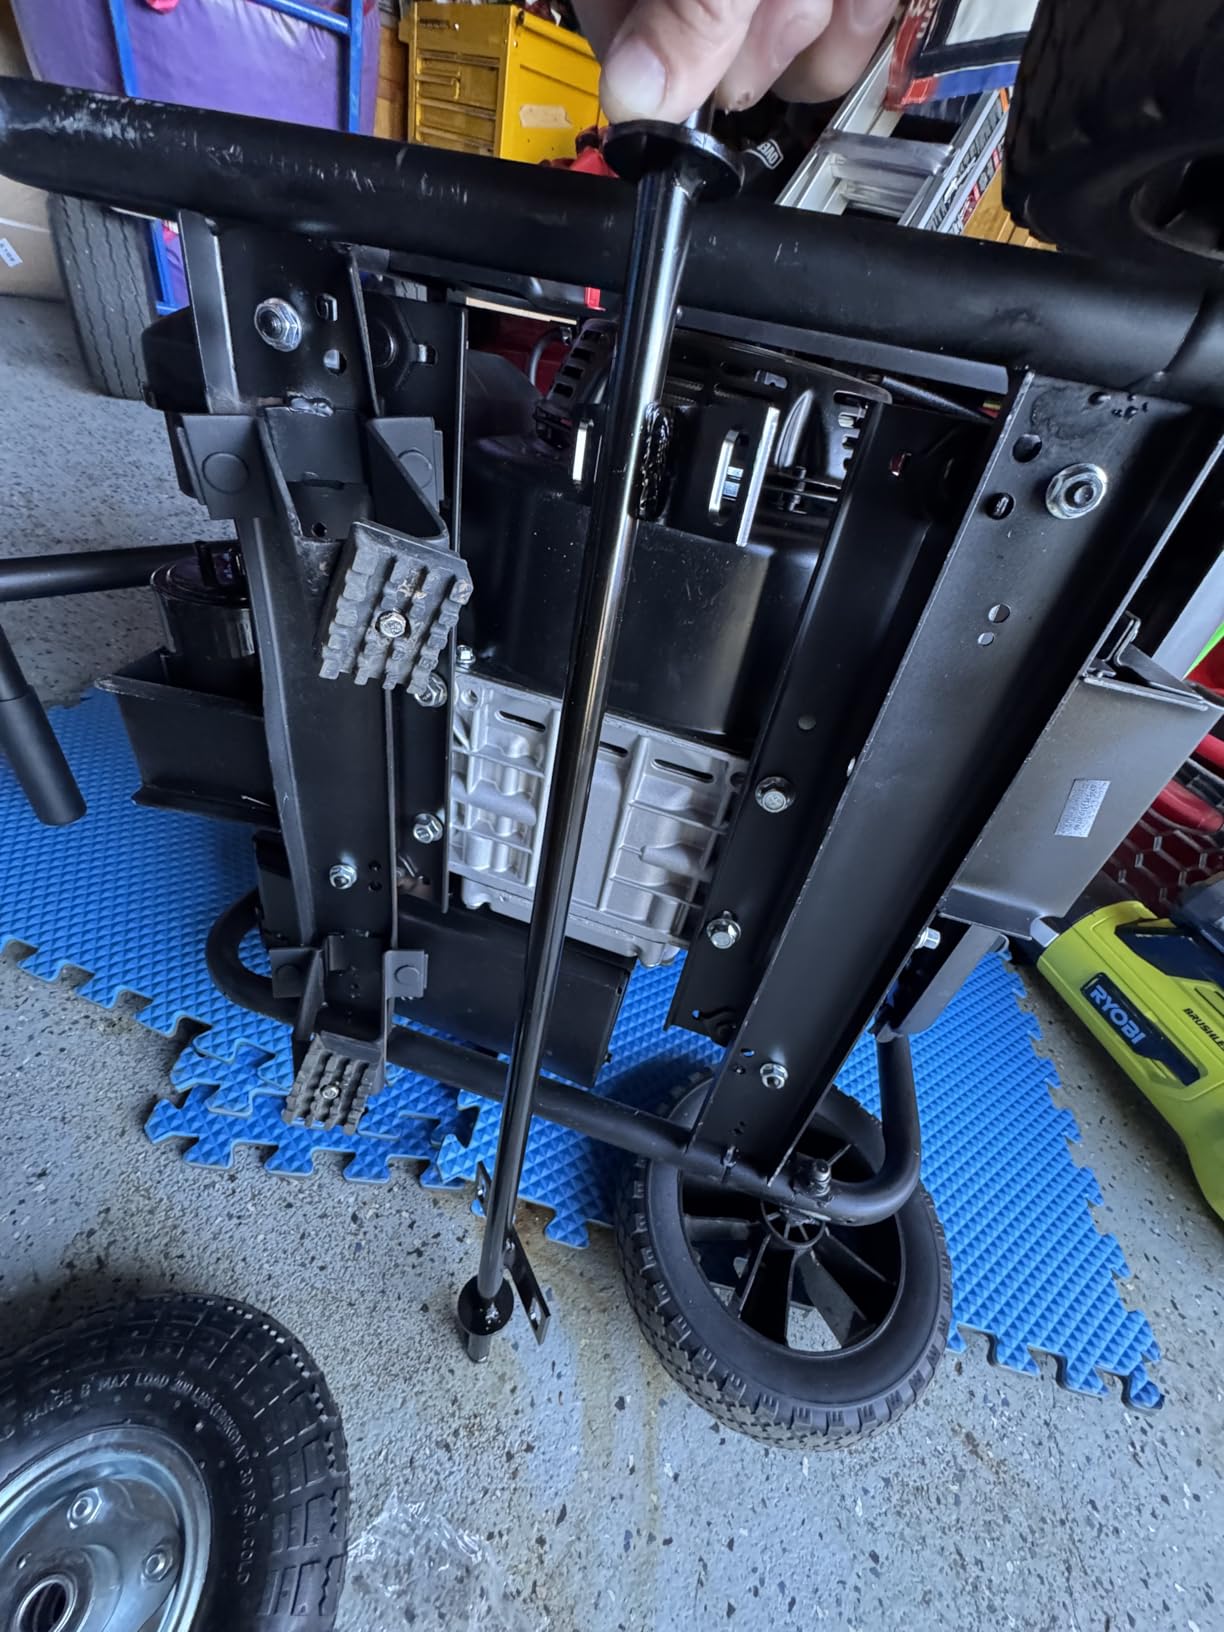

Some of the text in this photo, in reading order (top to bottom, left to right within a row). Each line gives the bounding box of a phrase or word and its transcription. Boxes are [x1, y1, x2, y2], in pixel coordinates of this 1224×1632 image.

[1090, 985, 1146, 1045] RYOBI
[98, 1374, 130, 1392] MAX
[134, 1373, 170, 1389] LOAD
